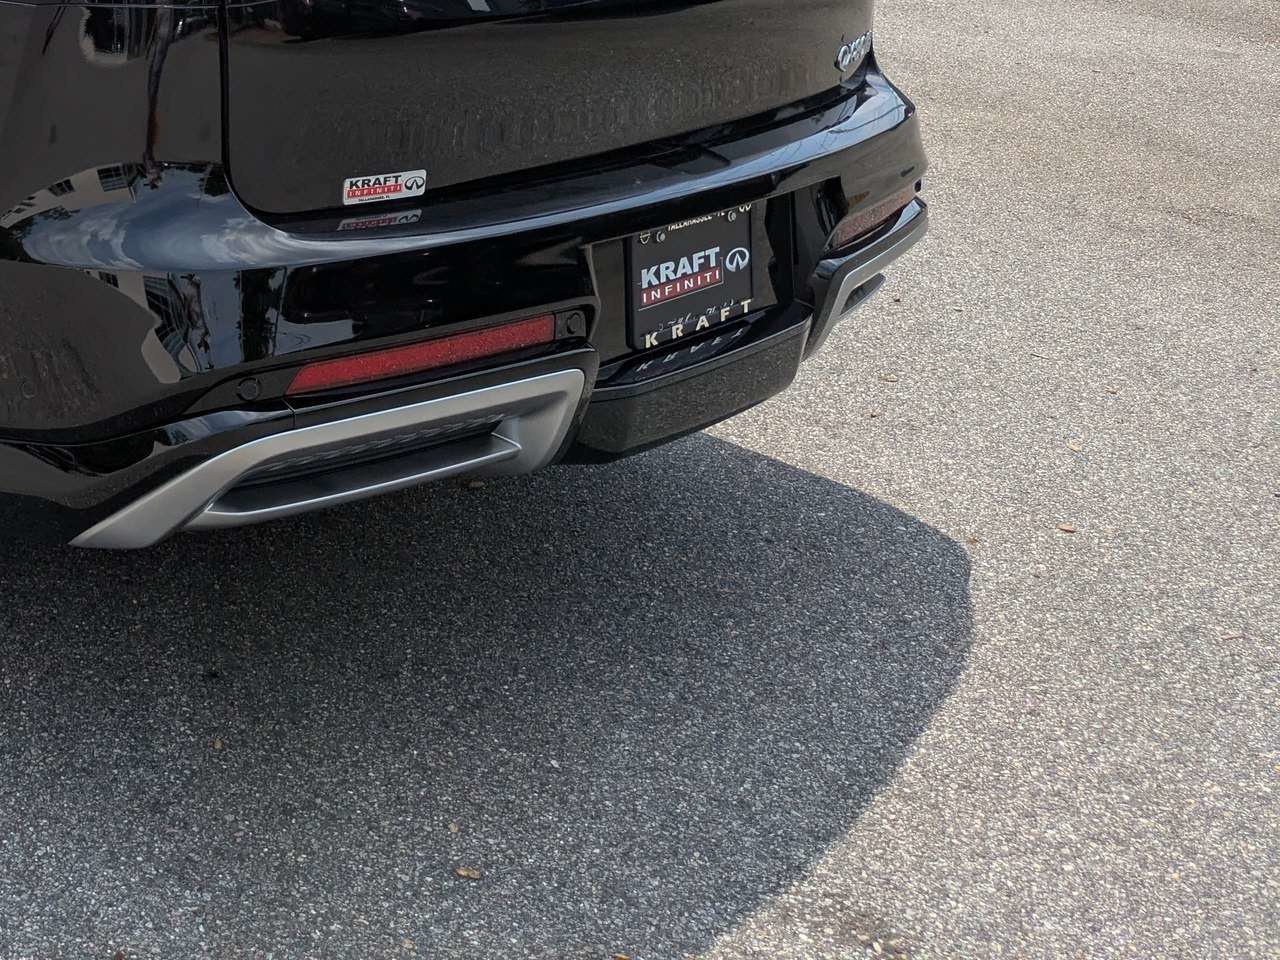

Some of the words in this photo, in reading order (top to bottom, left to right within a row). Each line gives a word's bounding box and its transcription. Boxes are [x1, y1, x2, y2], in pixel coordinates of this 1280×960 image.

[348, 184, 402, 197] INFINITI
[349, 175, 402, 189] KRAFT
[640, 246, 720, 289] KRAFT
[642, 270, 720, 304] INFINITI
[644, 298, 752, 349] KRAFT
